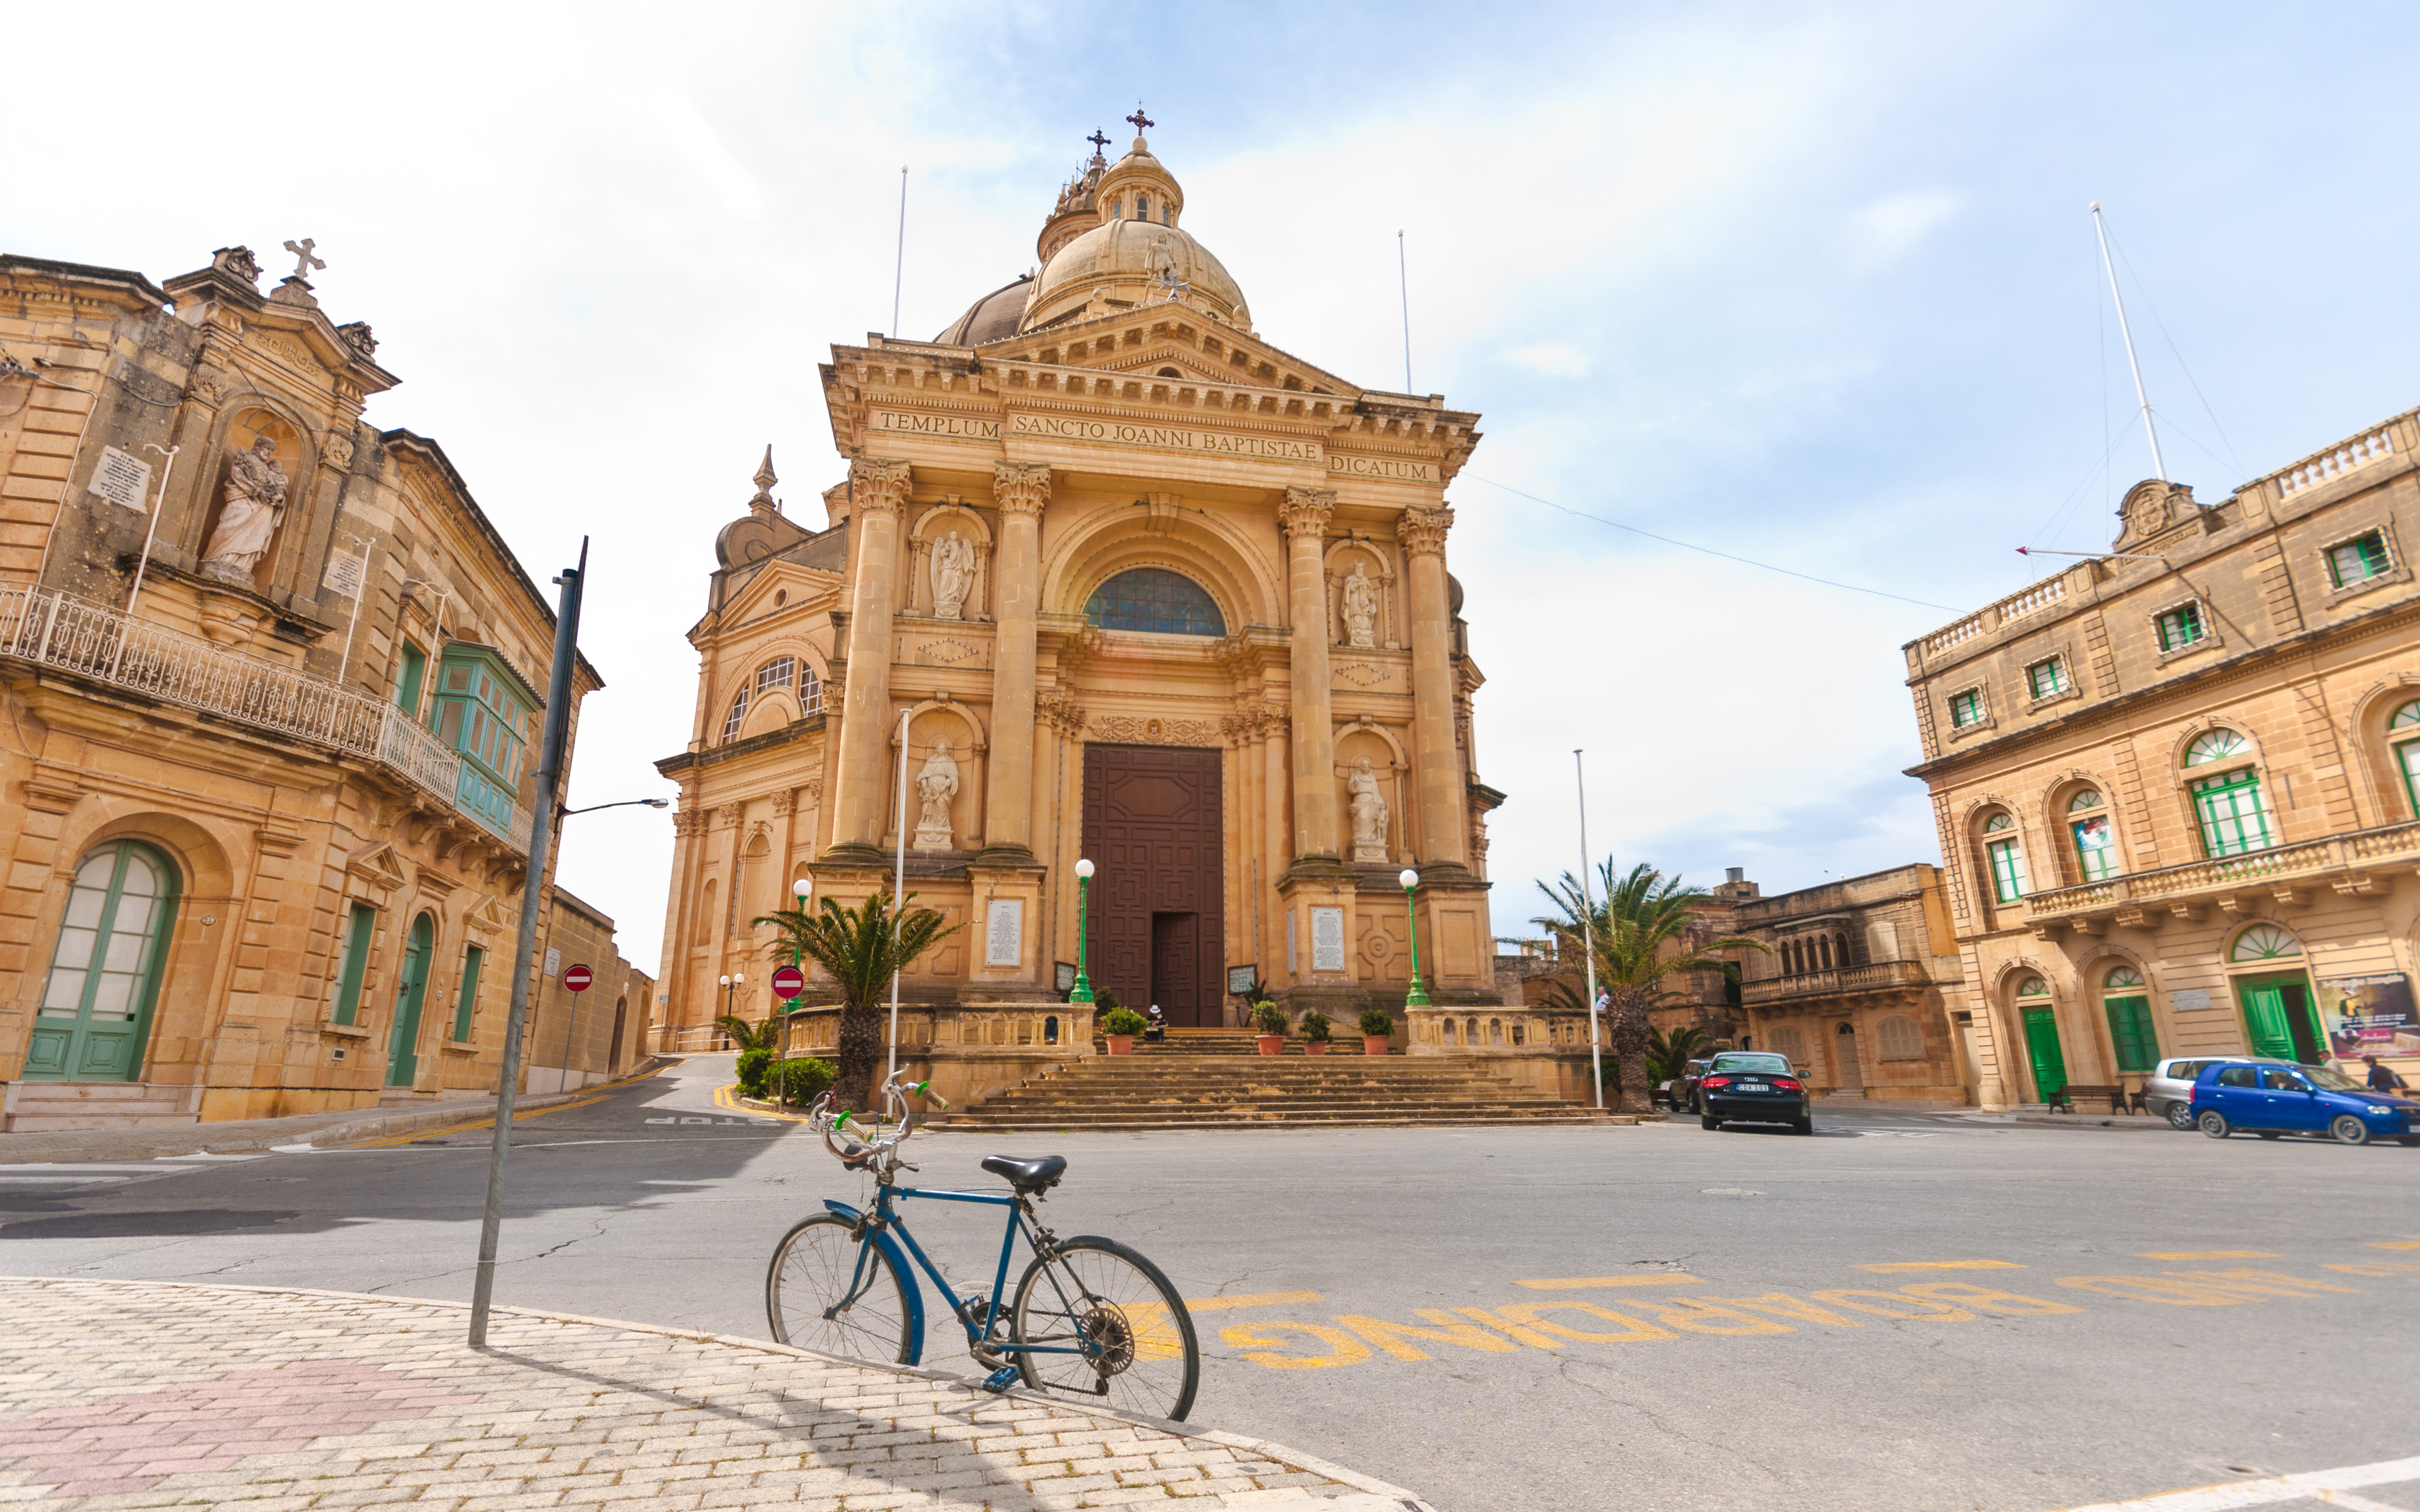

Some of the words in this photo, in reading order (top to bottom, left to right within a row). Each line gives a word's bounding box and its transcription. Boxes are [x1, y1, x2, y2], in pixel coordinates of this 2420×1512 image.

[880, 412, 1001, 438] TEMPLUM
[1015, 416, 1105, 438] SANCTO
[1113, 425, 1193, 447] JOANNI
[1203, 434, 1316, 459] BAPTISTAE
[1330, 456, 1428, 479] DICATUM
[644, 1116, 781, 1126] STOP
[1221, 1283, 2088, 1369] BOARDING
